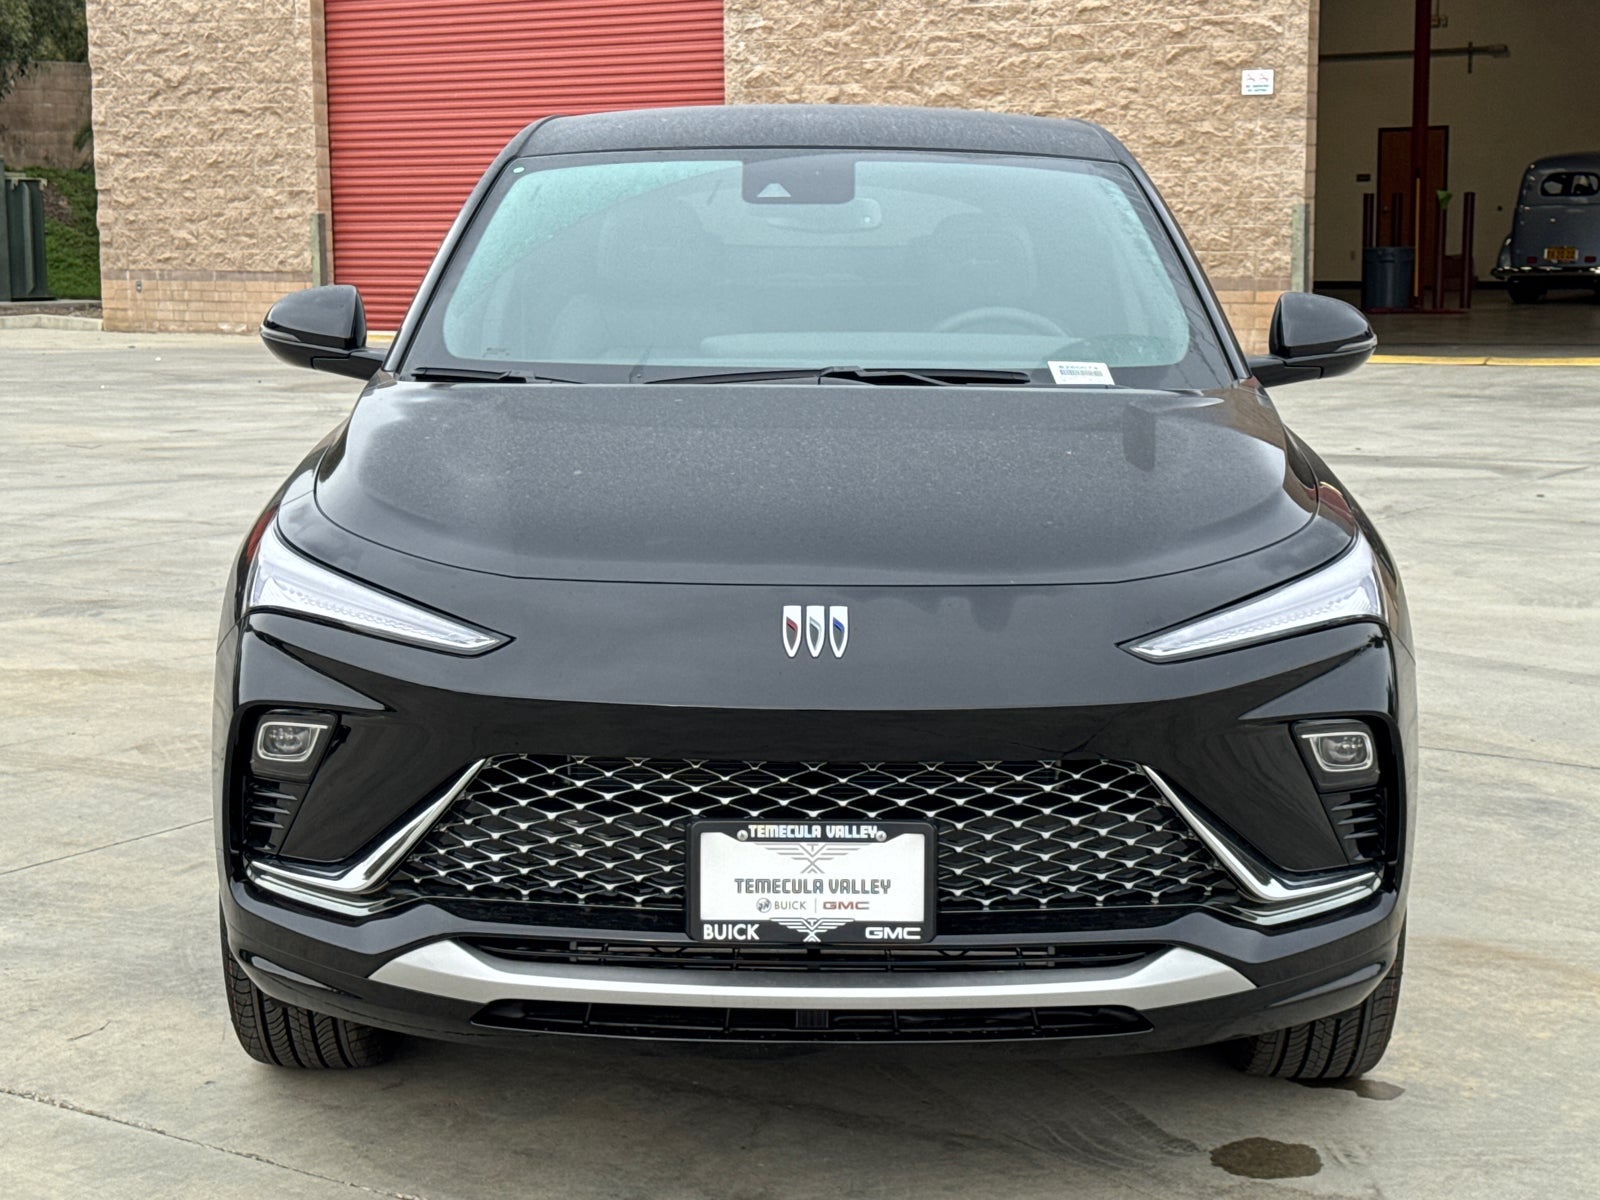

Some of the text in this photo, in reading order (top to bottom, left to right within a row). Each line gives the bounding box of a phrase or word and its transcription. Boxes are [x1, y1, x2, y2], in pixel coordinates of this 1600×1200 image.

[748, 824, 878, 839] TEMECULA VALLEY
[734, 878, 892, 895] TEMECULA VALLEY
[774, 900, 870, 910] BUICK GMC
[703, 924, 922, 940] BUICK GMC
